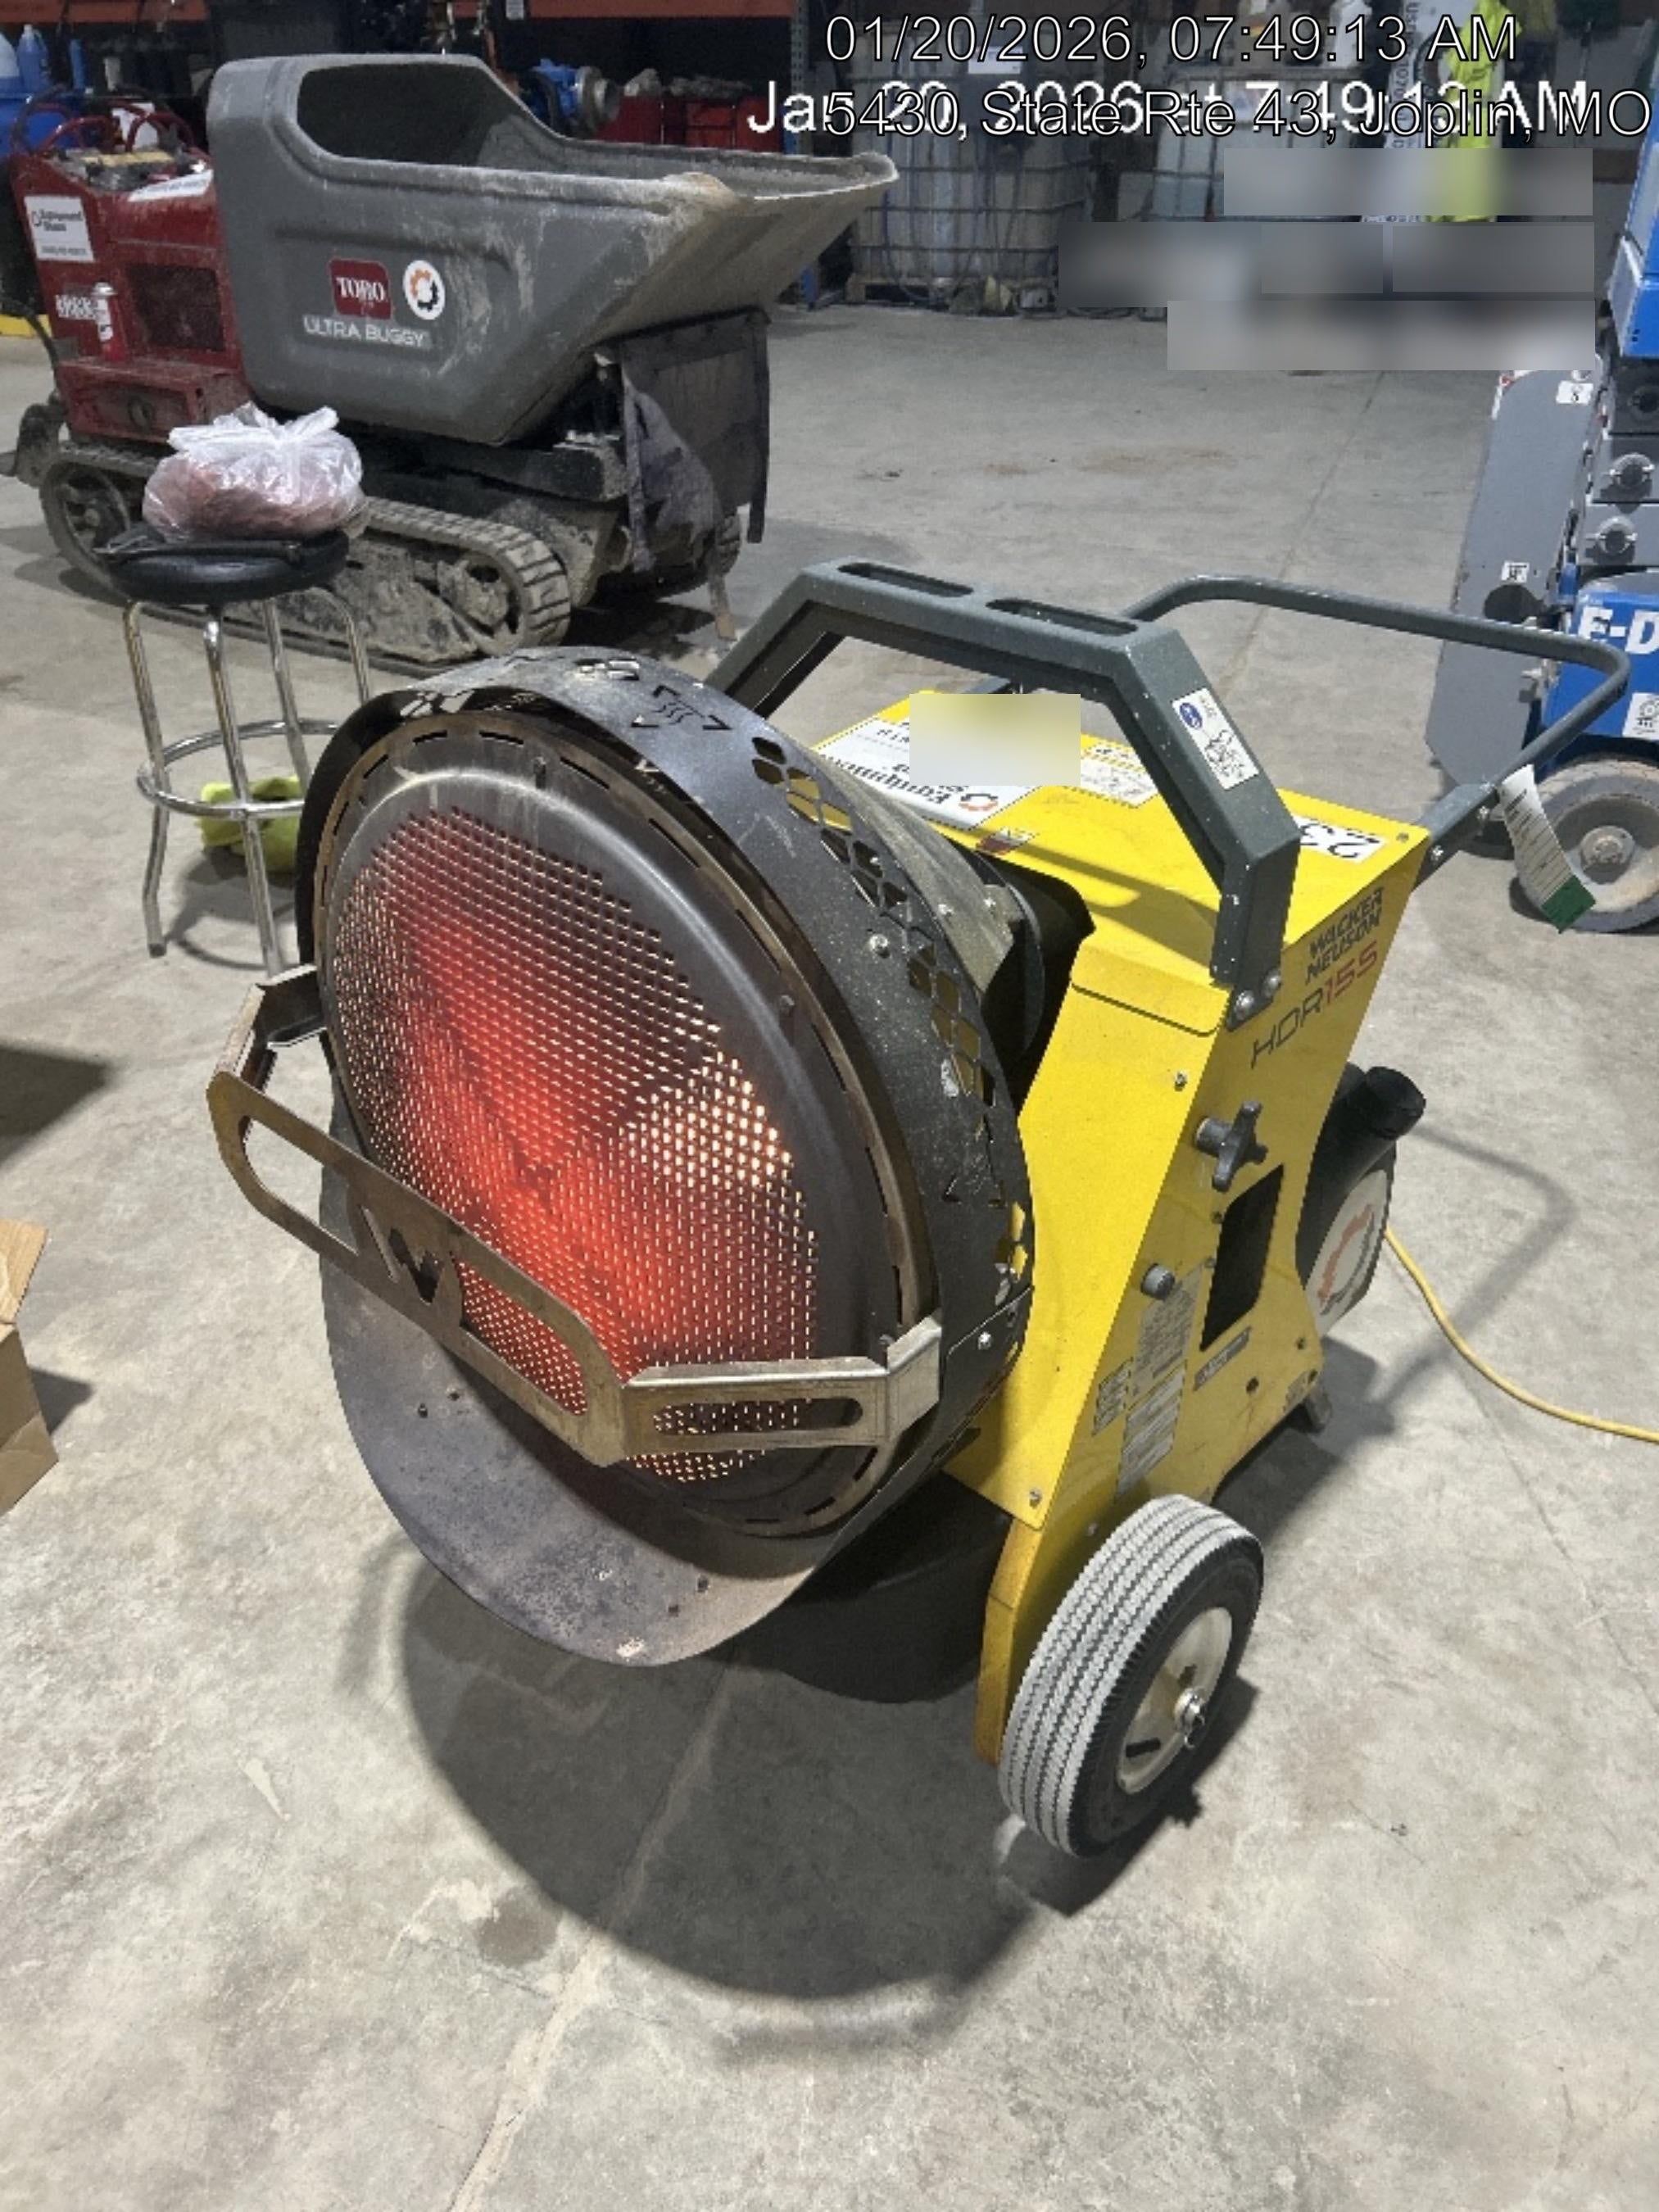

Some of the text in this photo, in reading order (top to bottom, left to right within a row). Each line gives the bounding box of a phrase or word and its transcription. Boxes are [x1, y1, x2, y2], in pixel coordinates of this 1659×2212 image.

[336, 276, 387, 302] TORO
[303, 314, 424, 348] ULTRA BUGGY
[1304, 907, 1383, 985] NEUSON
[1309, 887, 1385, 959] WACKER
